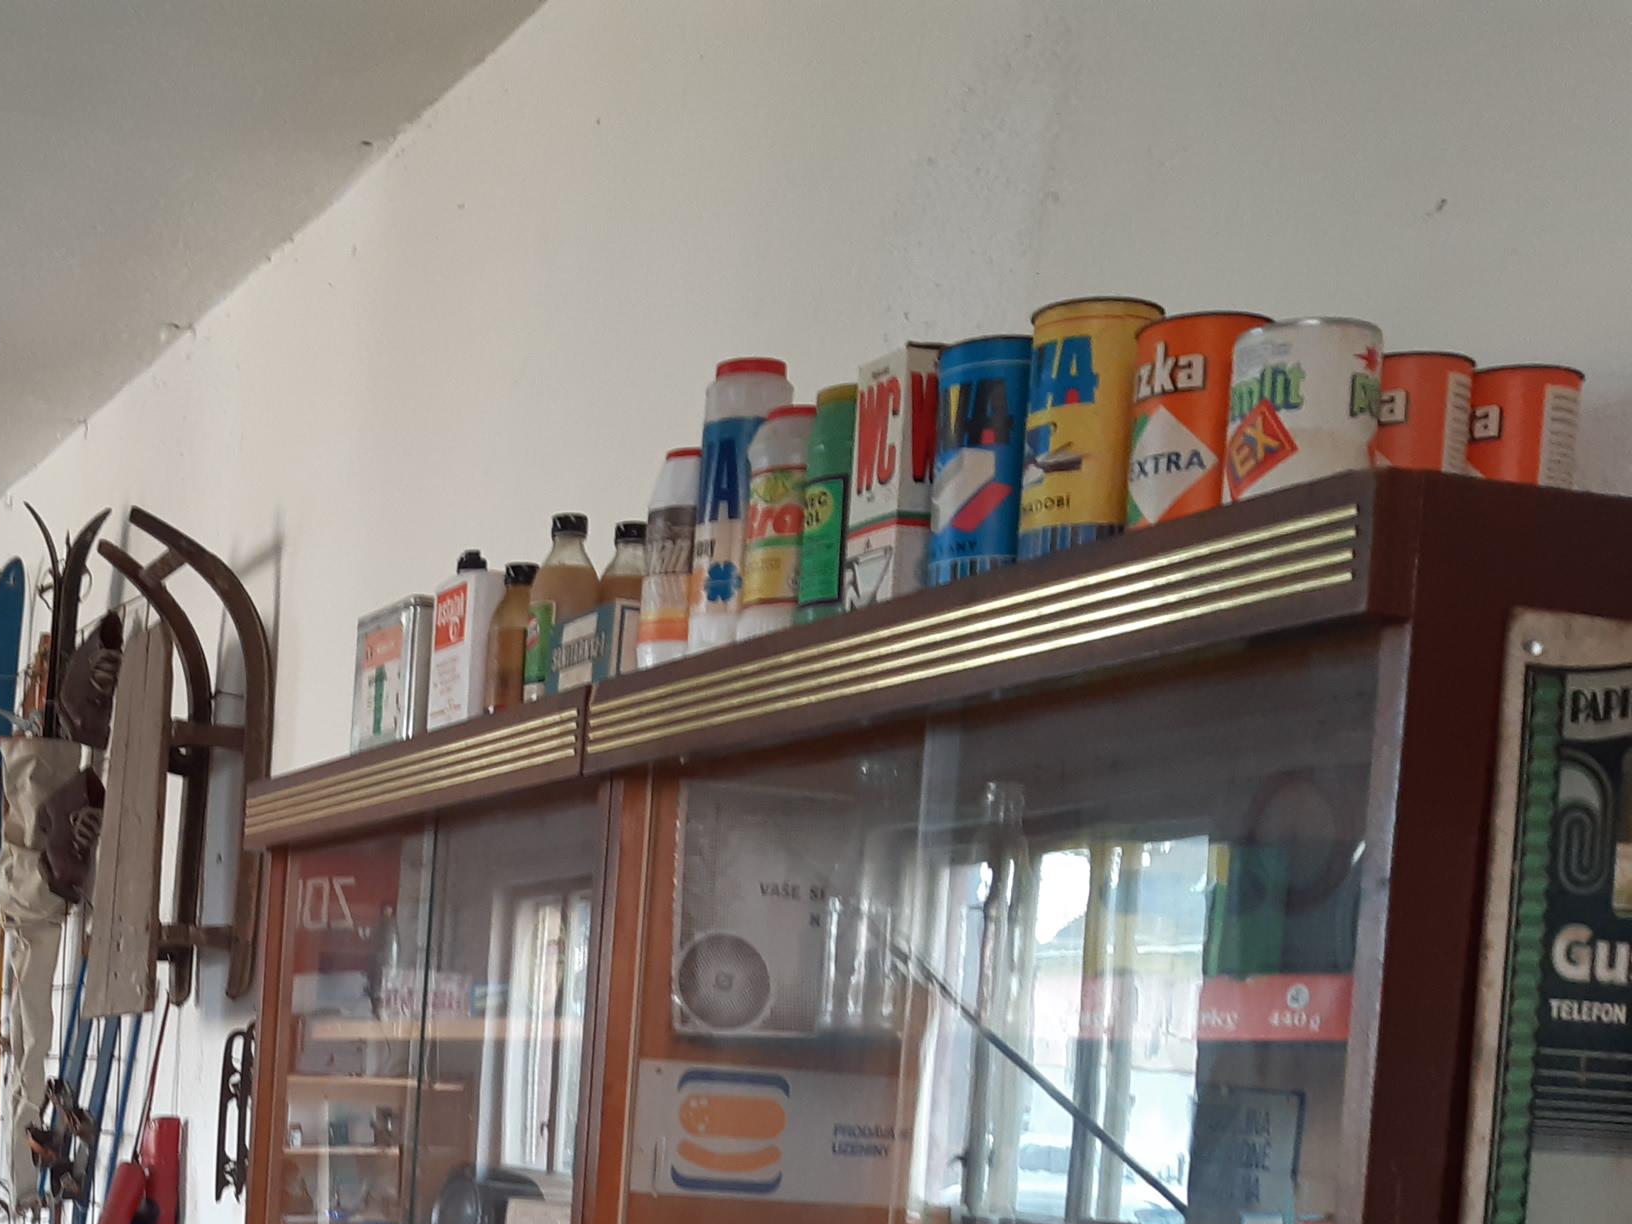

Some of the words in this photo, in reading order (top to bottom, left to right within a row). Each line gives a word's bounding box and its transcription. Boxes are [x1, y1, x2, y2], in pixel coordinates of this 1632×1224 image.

[1135, 341, 1206, 402] zka
[857, 376, 902, 496] WC
[1552, 922, 1632, 985] Gu
[1548, 997, 1628, 1026] TELEFON
